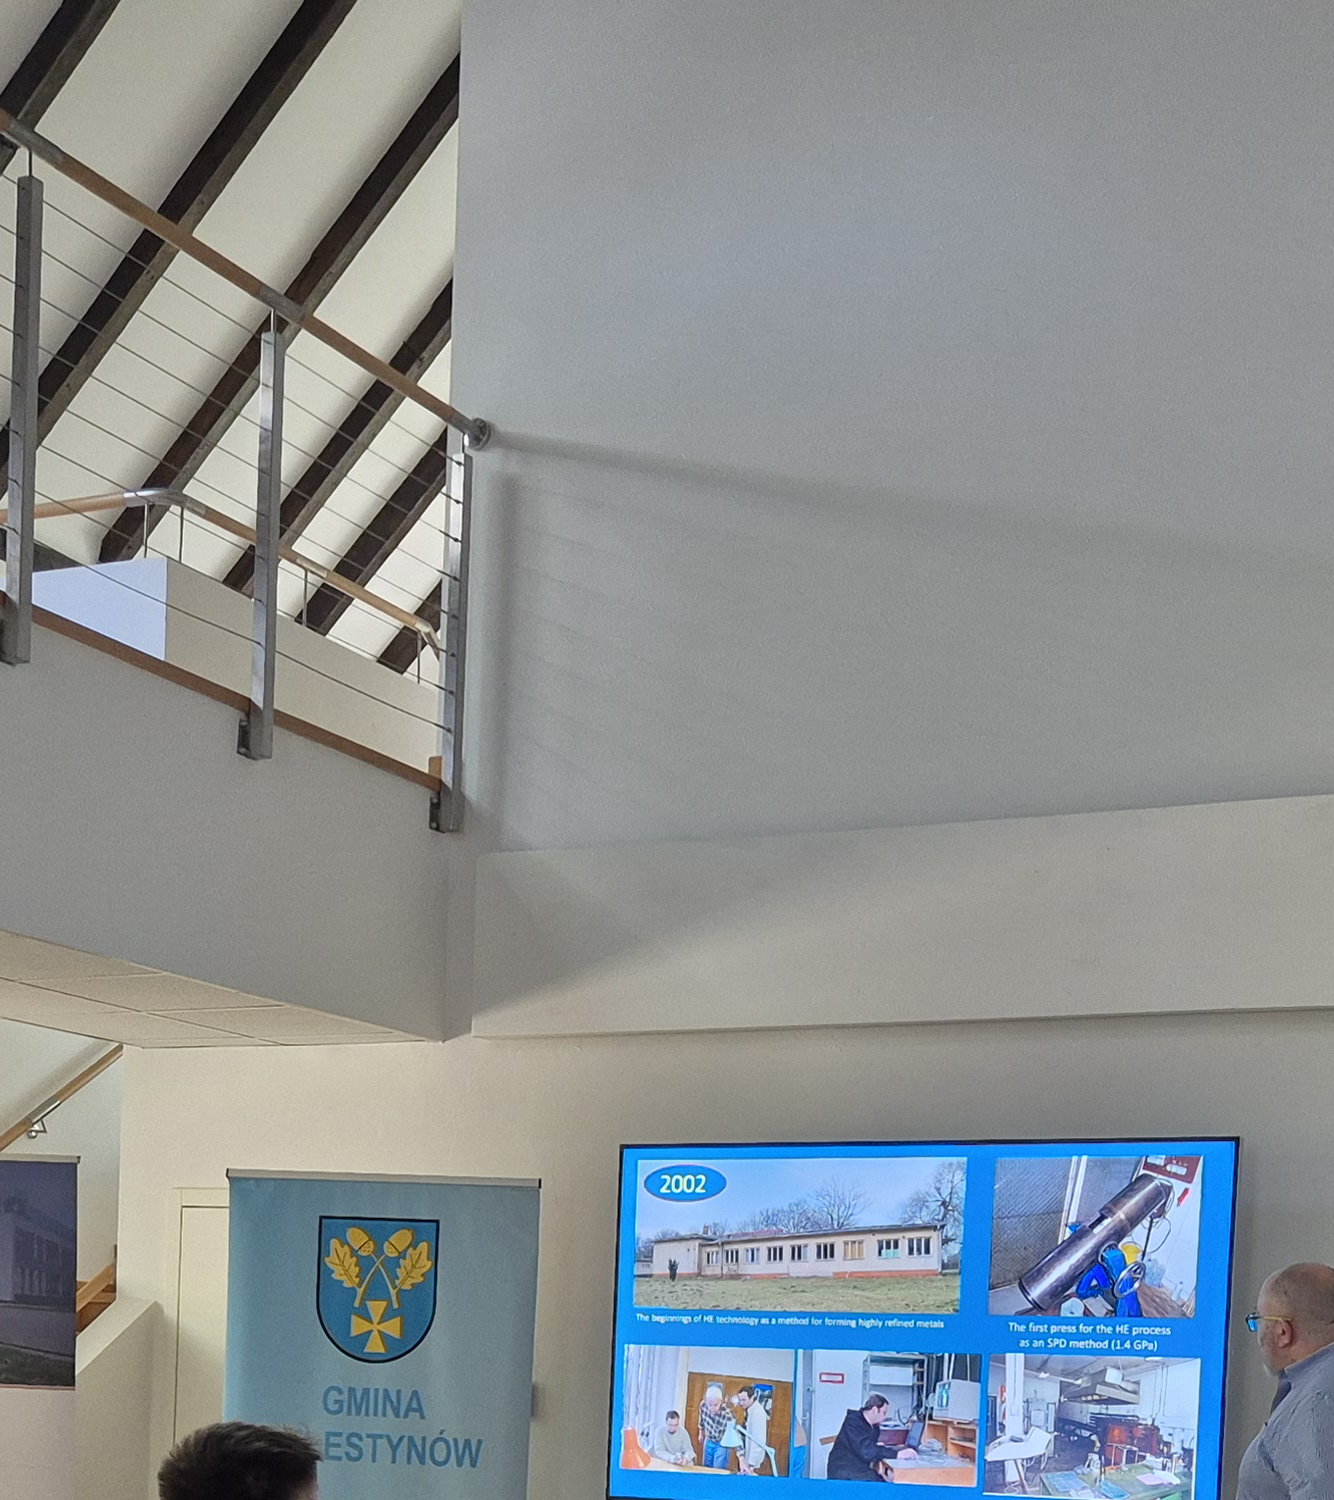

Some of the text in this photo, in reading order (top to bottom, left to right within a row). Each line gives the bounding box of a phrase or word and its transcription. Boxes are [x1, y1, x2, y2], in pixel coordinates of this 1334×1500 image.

[660, 1174, 707, 1193] 2002
[635, 1313, 650, 1322] The
[651, 1314, 692, 1324] beginnings
[693, 1314, 702, 1323] of
[703, 1315, 714, 1323] HE
[716, 1315, 759, 1326] technology
[760, 1317, 770, 1325] as
[778, 1316, 809, 1326] method
[811, 1317, 823, 1326] for
[824, 1317, 857, 1328] forming
[858, 1318, 883, 1329] highly
[884, 1318, 915, 1328] refined
[916, 1318, 945, 1329] metals
[1008, 1322, 1172, 1336] The first press for the HE process
[1019, 1338, 1158, 1352] as an SPD method (1.4 GPa)
[322, 1385, 426, 1420] GMINA
[324, 1429, 483, 1469] ESTYNÓW
